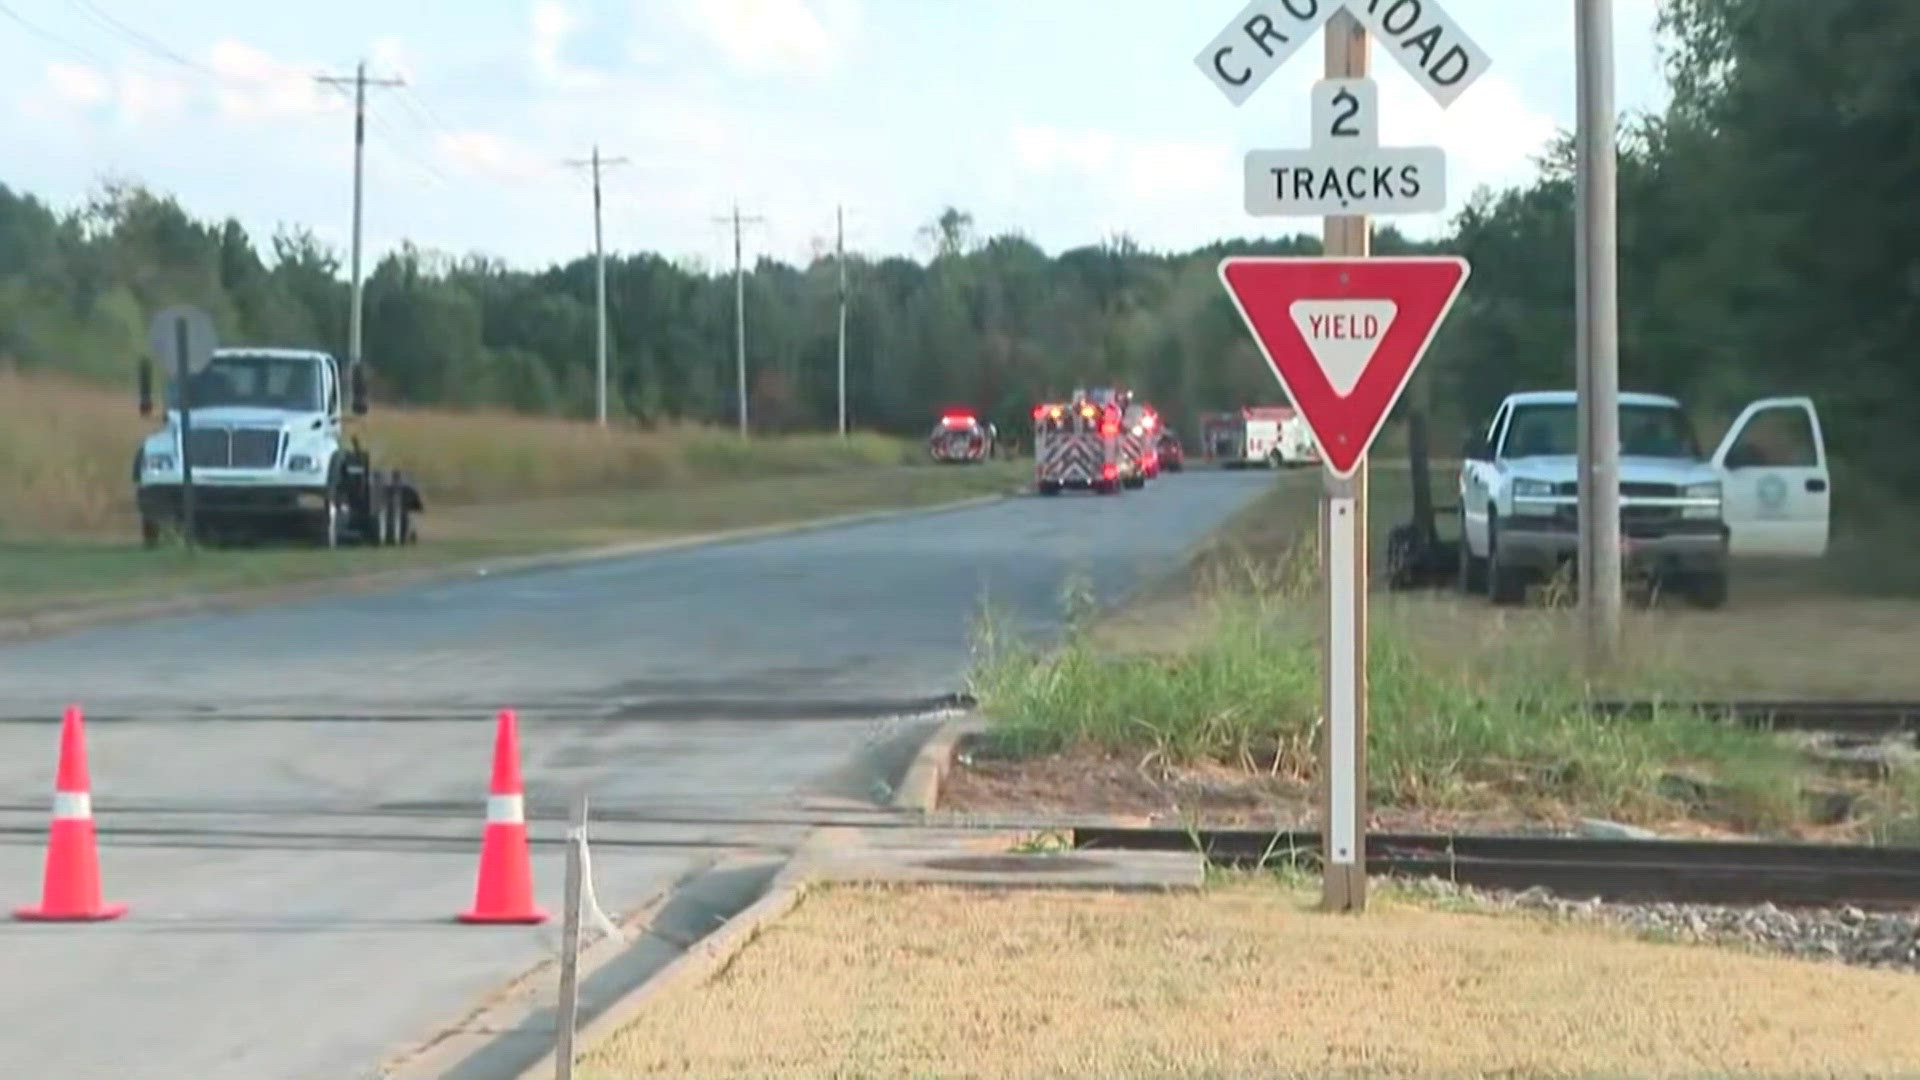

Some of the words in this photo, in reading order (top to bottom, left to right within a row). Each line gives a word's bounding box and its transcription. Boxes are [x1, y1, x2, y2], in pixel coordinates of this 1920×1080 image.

[1367, 0, 1469, 86] OAD
[1330, 92, 1360, 137] 2
[1270, 166, 1421, 201] TRACKS
[1308, 314, 1379, 340] YIELD
